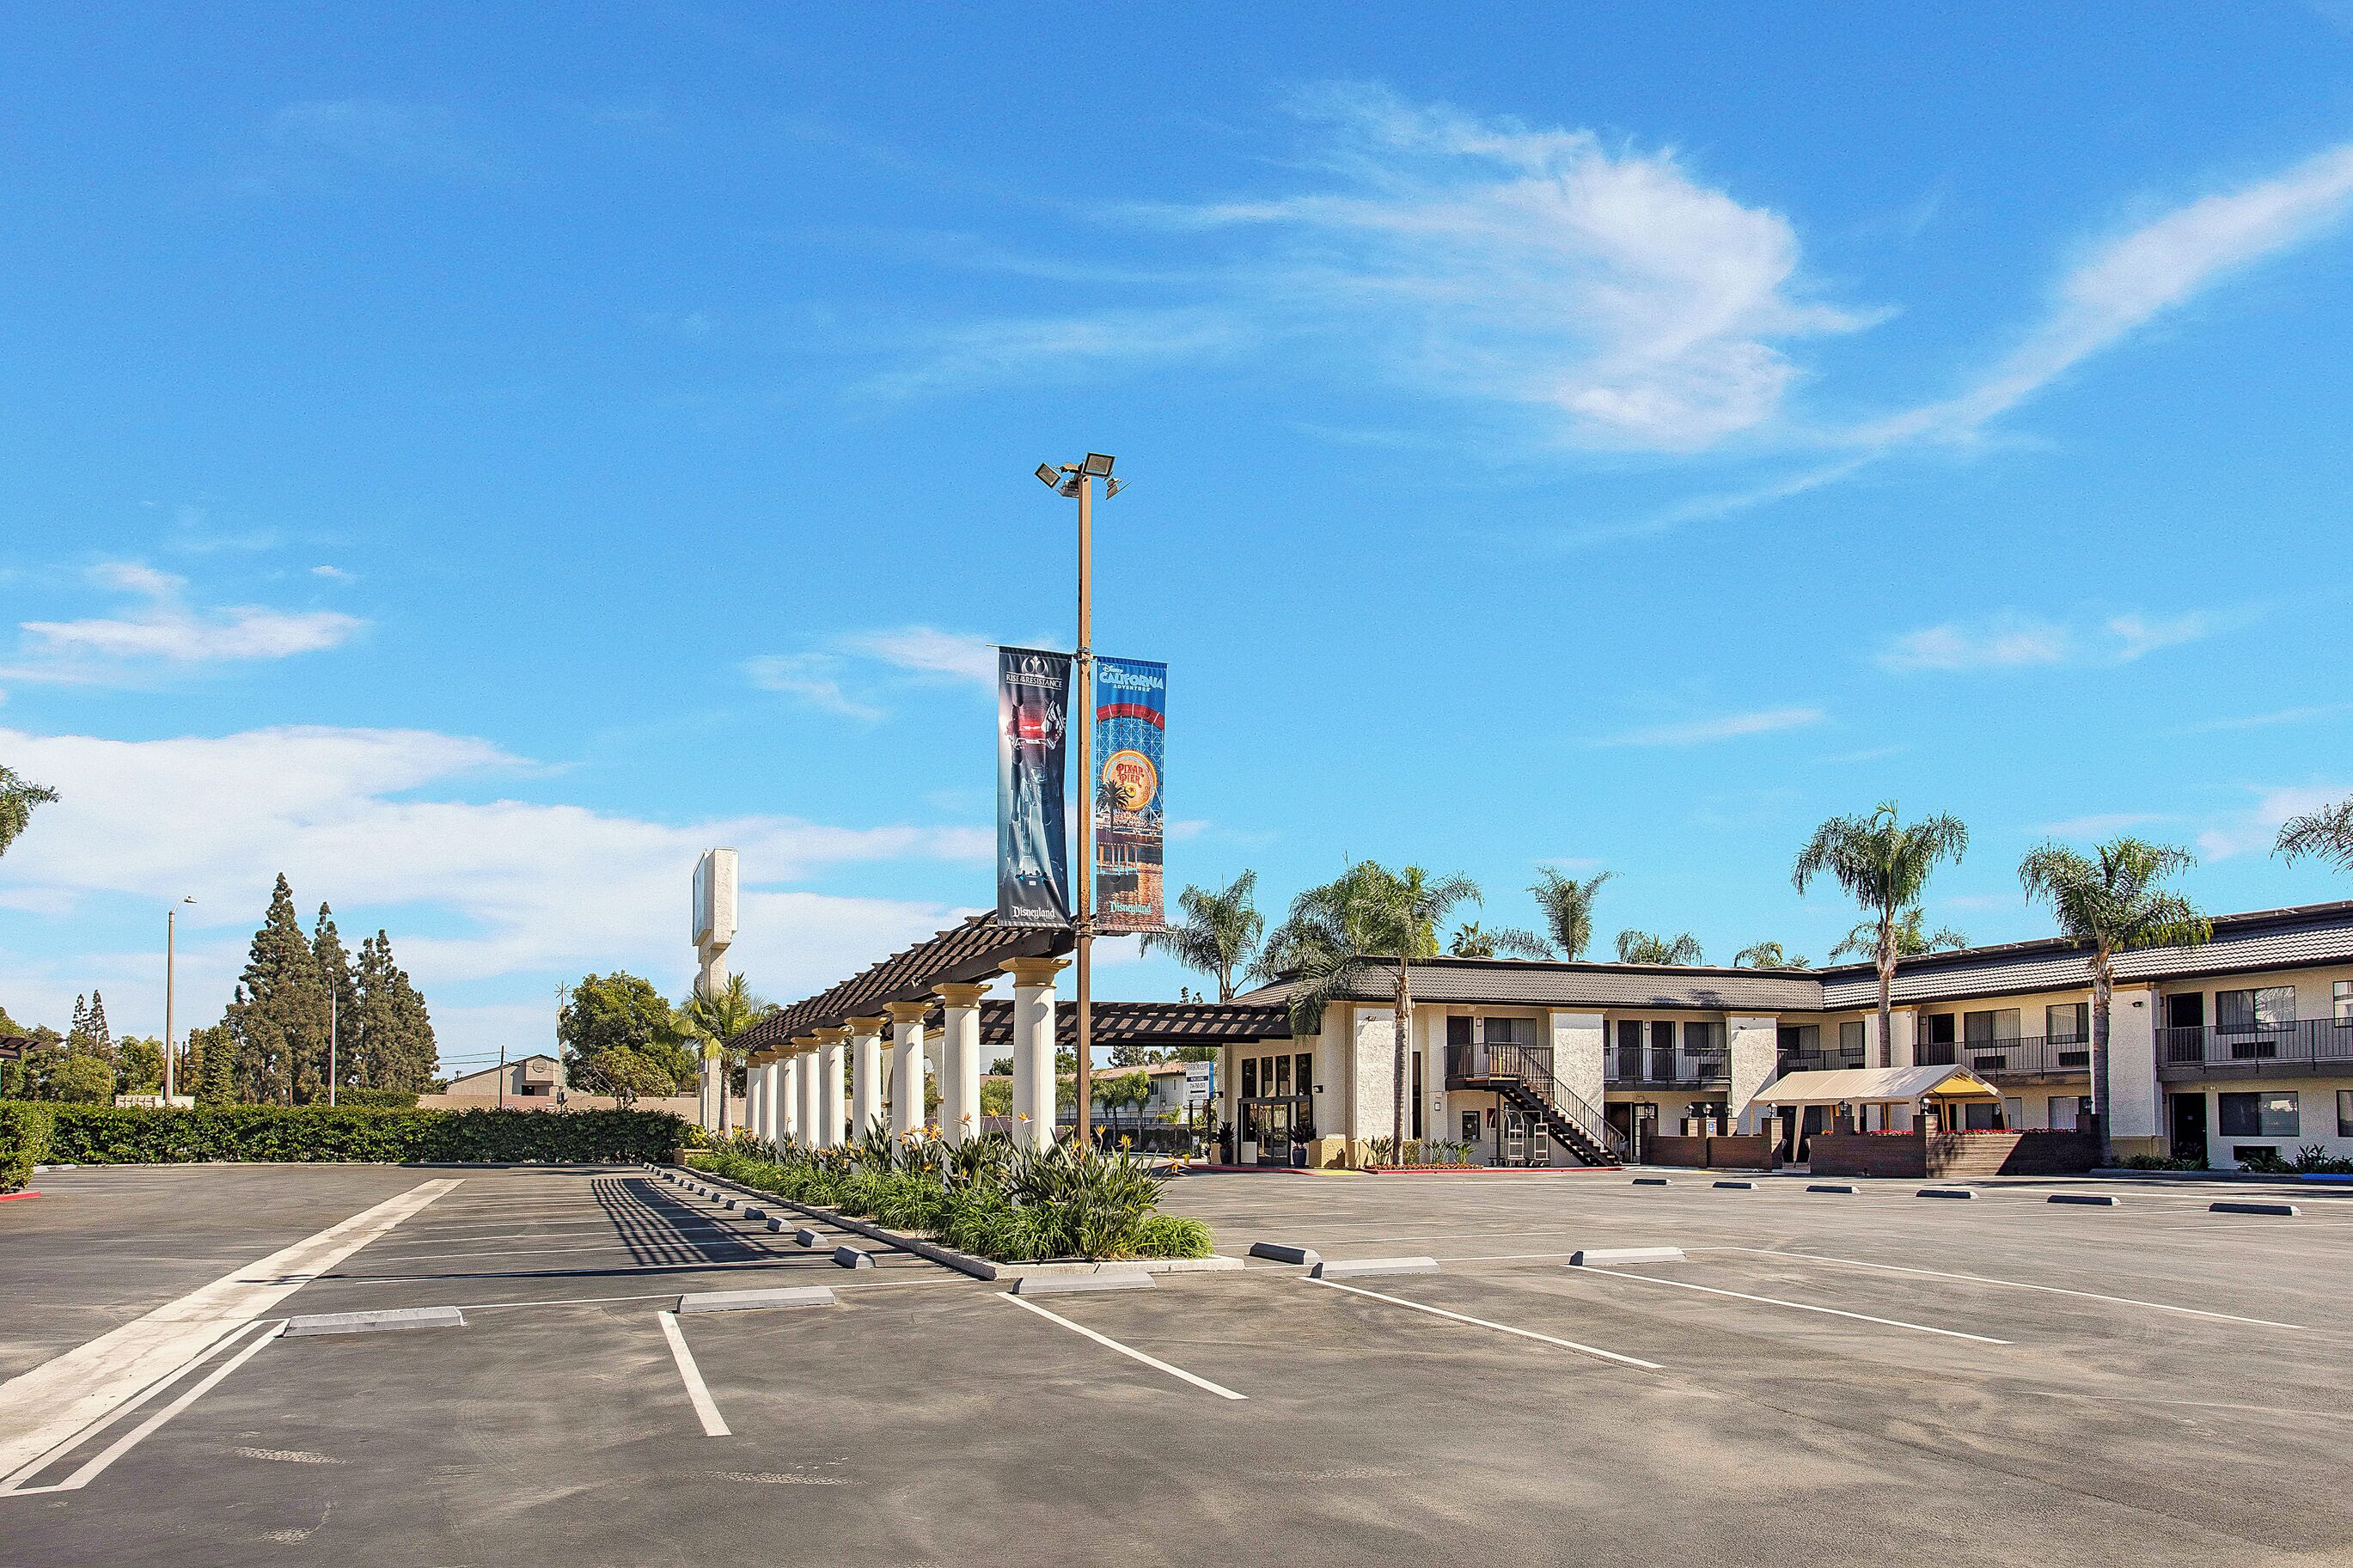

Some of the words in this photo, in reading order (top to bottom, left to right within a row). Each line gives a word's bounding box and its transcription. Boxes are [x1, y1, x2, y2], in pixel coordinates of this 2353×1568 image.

[1101, 663, 1123, 674] Disney
[1006, 674, 1020, 682] RISE
[1025, 676, 1062, 687] RESISTANCE
[1099, 672, 1164, 689] CALIFORNIA
[1116, 763, 1144, 778] PIXAR
[1120, 774, 1142, 788] PIER
[1011, 905, 1056, 918] Disneyland
[1109, 900, 1152, 914] Disneyland
